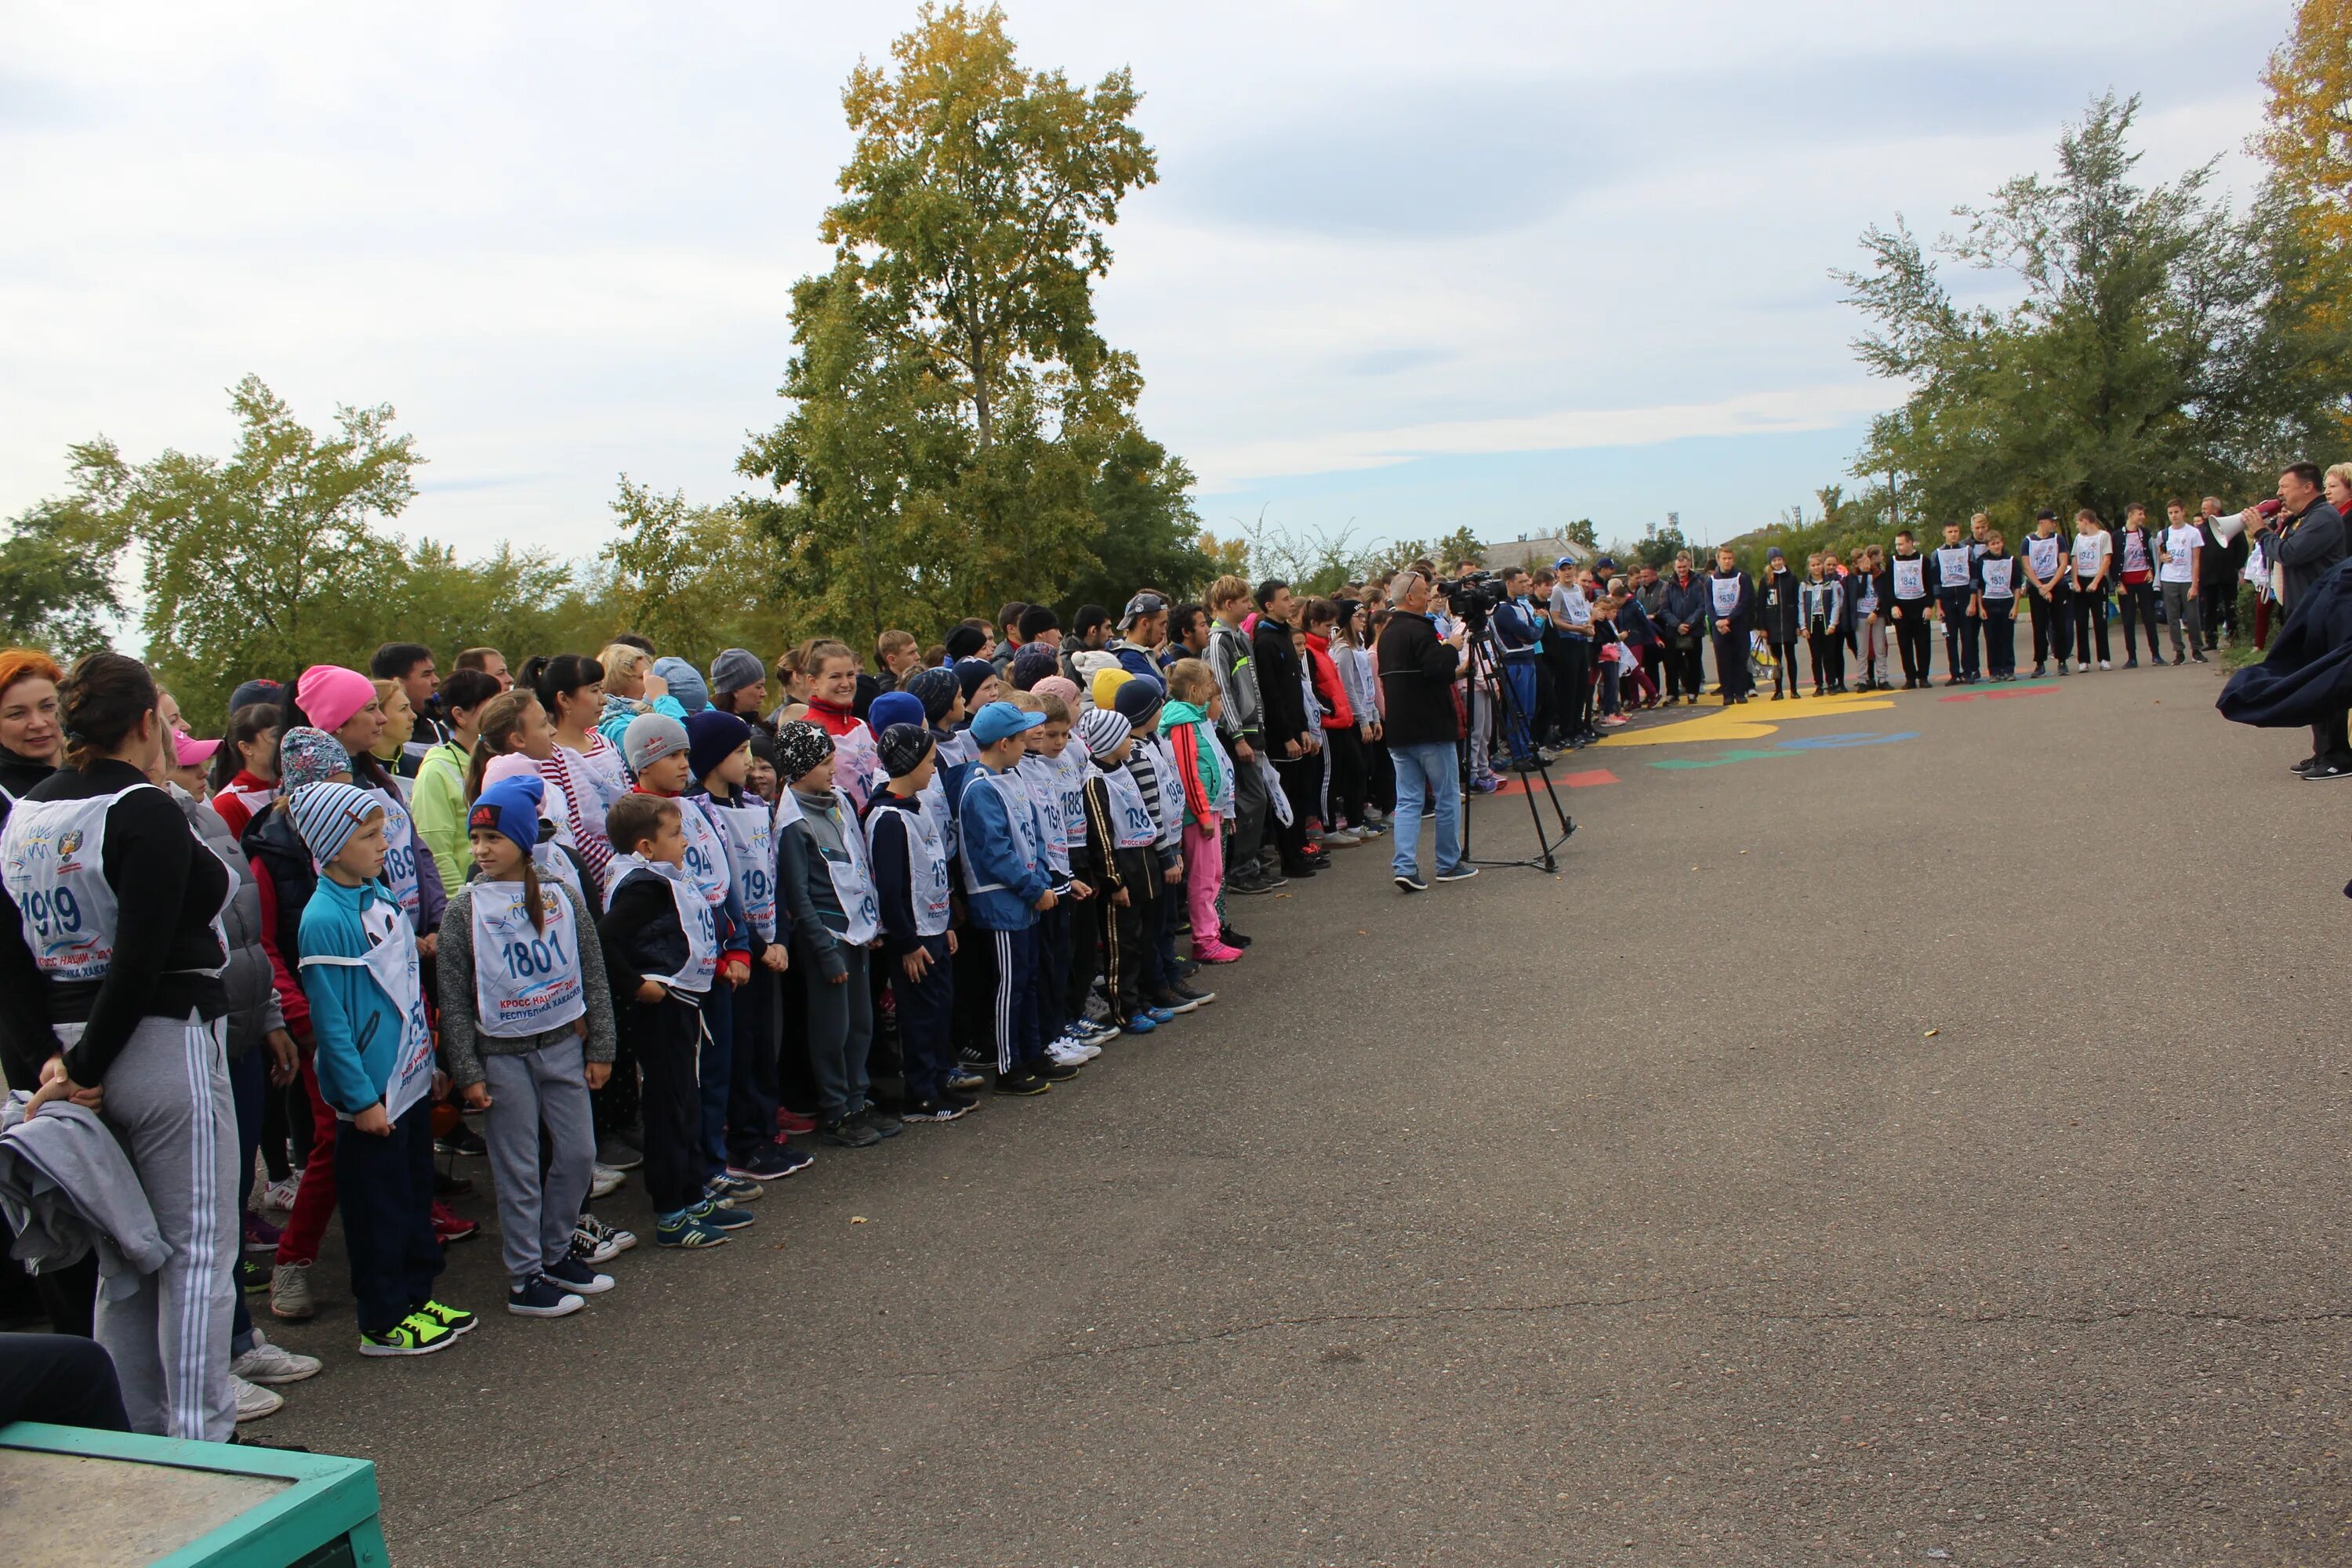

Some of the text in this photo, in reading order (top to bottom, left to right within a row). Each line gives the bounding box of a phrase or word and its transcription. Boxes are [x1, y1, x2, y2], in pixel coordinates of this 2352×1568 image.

[20, 887, 82, 936] 1919
[60, 953, 89, 966] НАЦИИ
[503, 930, 568, 979] 1801
[500, 999, 530, 1009] КРОСС
